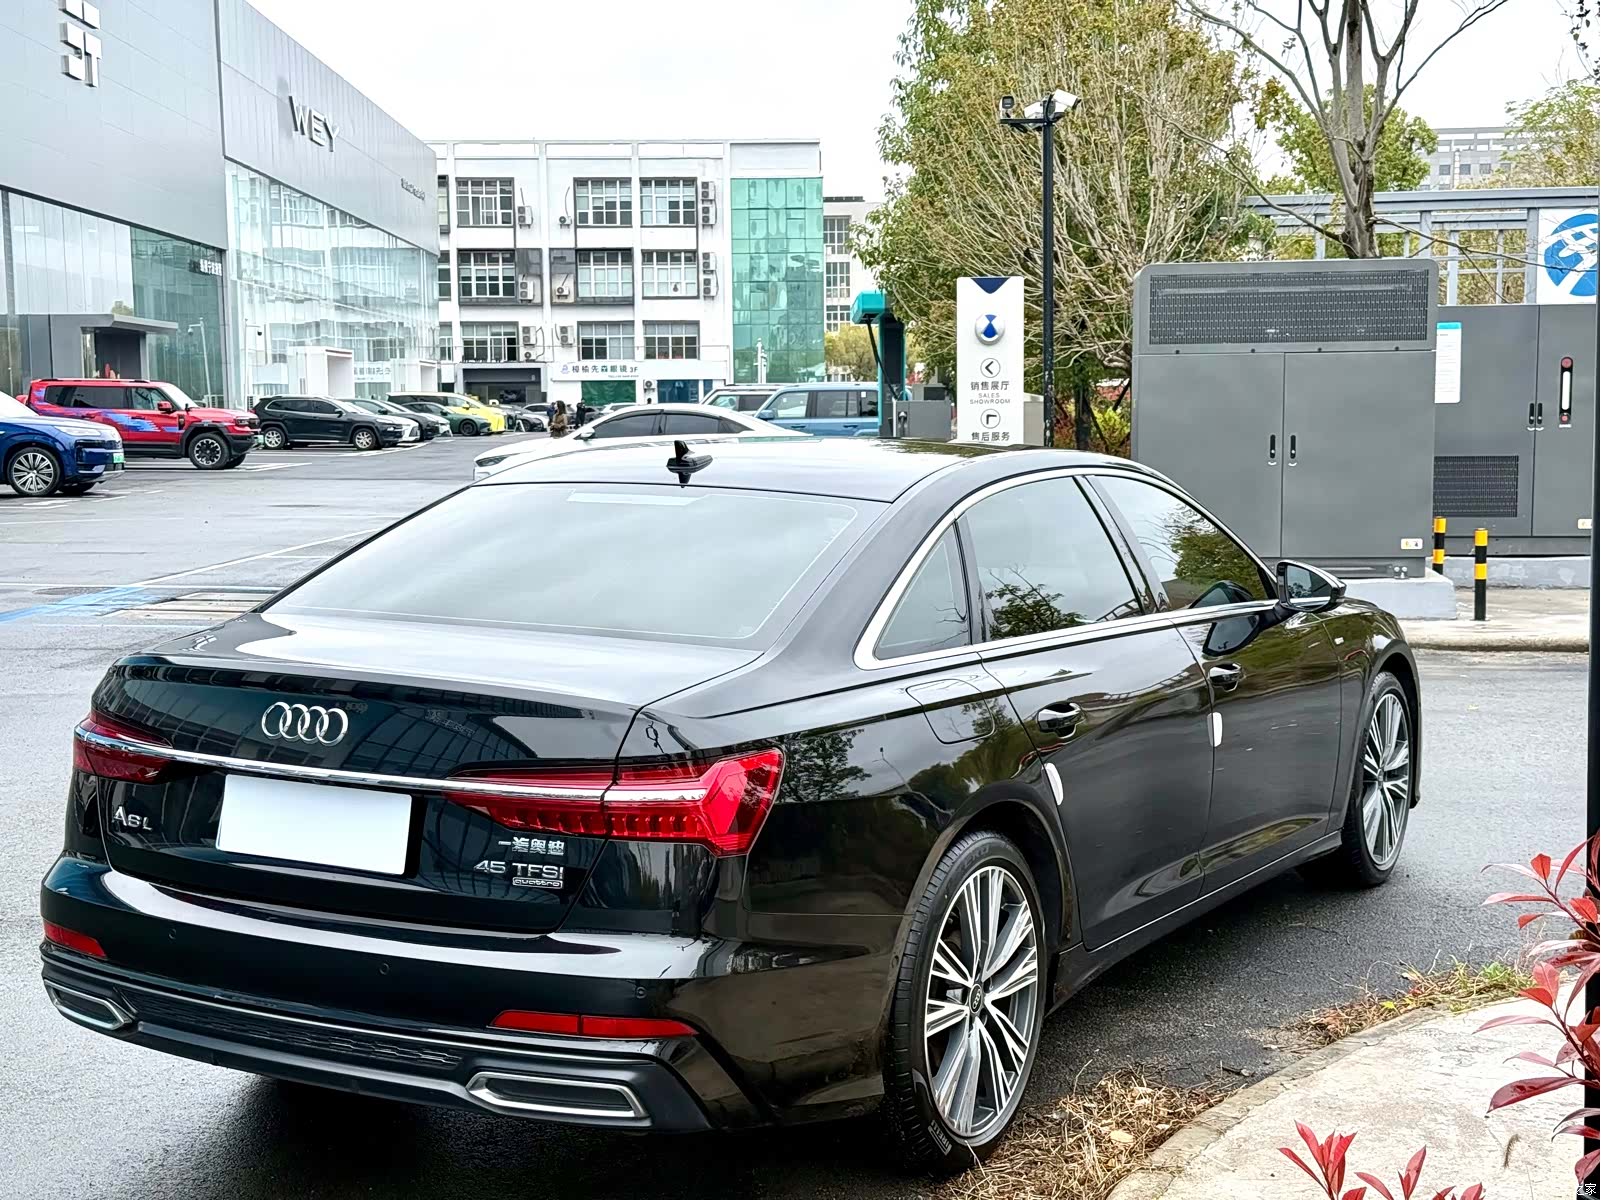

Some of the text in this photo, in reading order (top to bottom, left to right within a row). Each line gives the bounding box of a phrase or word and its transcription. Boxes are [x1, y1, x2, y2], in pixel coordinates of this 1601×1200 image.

[288, 95, 340, 152] WEY
[970, 380, 1010, 391] 销售展厅
[971, 431, 1010, 441] 售后服务
[112, 805, 153, 831] A6L
[474, 860, 564, 880] 45 TFSI
[514, 878, 562, 888] quattro
[927, 1119, 953, 1156] PIRELLI
